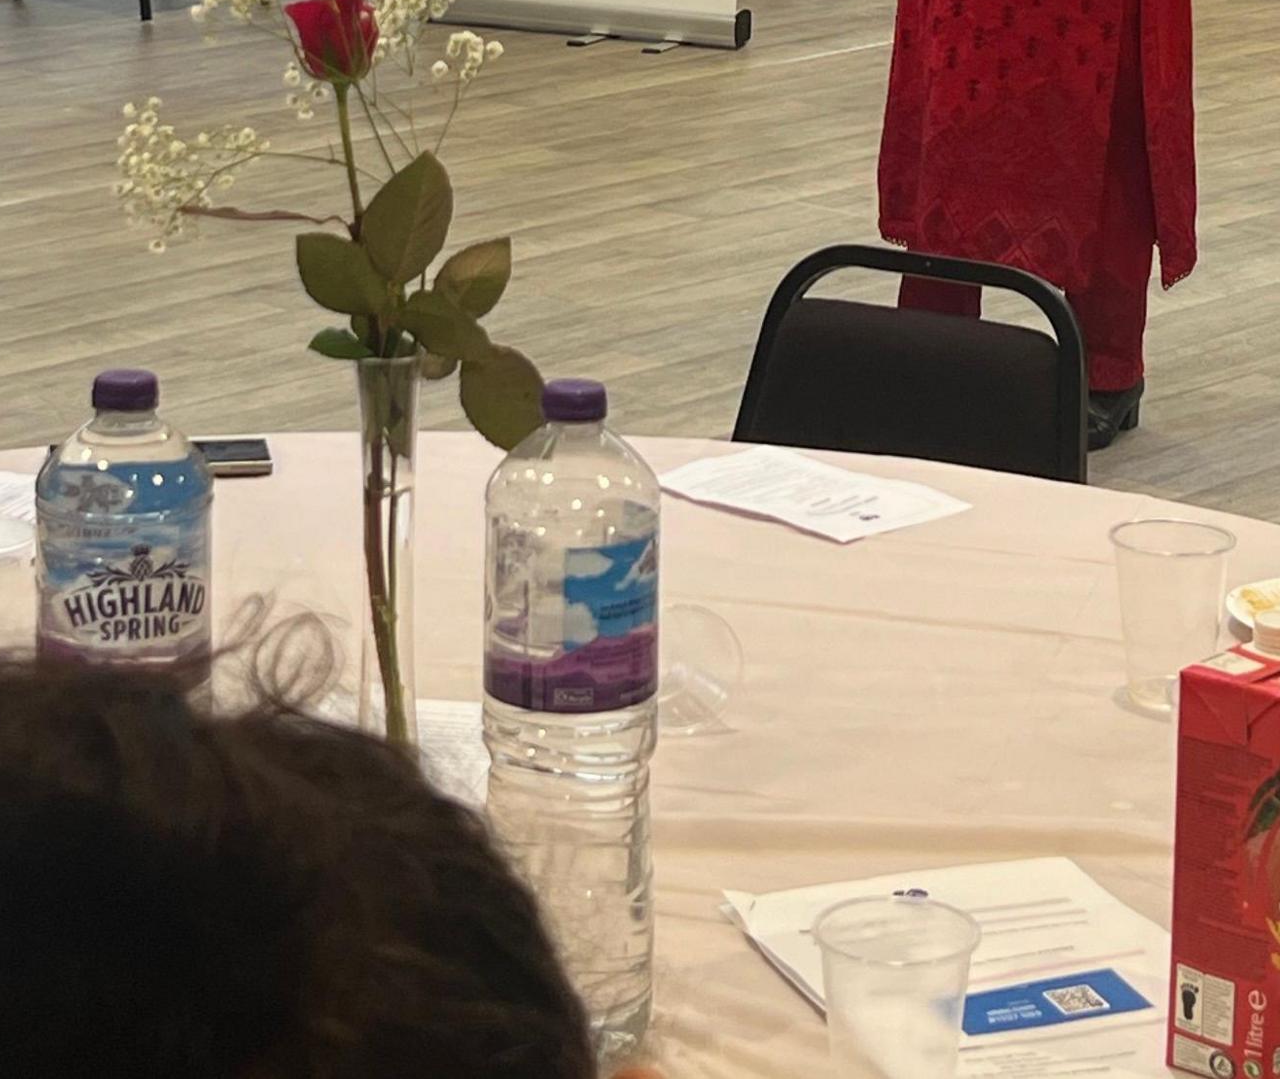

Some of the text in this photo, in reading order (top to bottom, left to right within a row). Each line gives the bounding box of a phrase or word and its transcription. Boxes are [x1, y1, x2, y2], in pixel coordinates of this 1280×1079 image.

[64, 584, 206, 627] HIGHLAND
[100, 614, 182, 641] SPRING
[1245, 1013, 1265, 1047] litre
